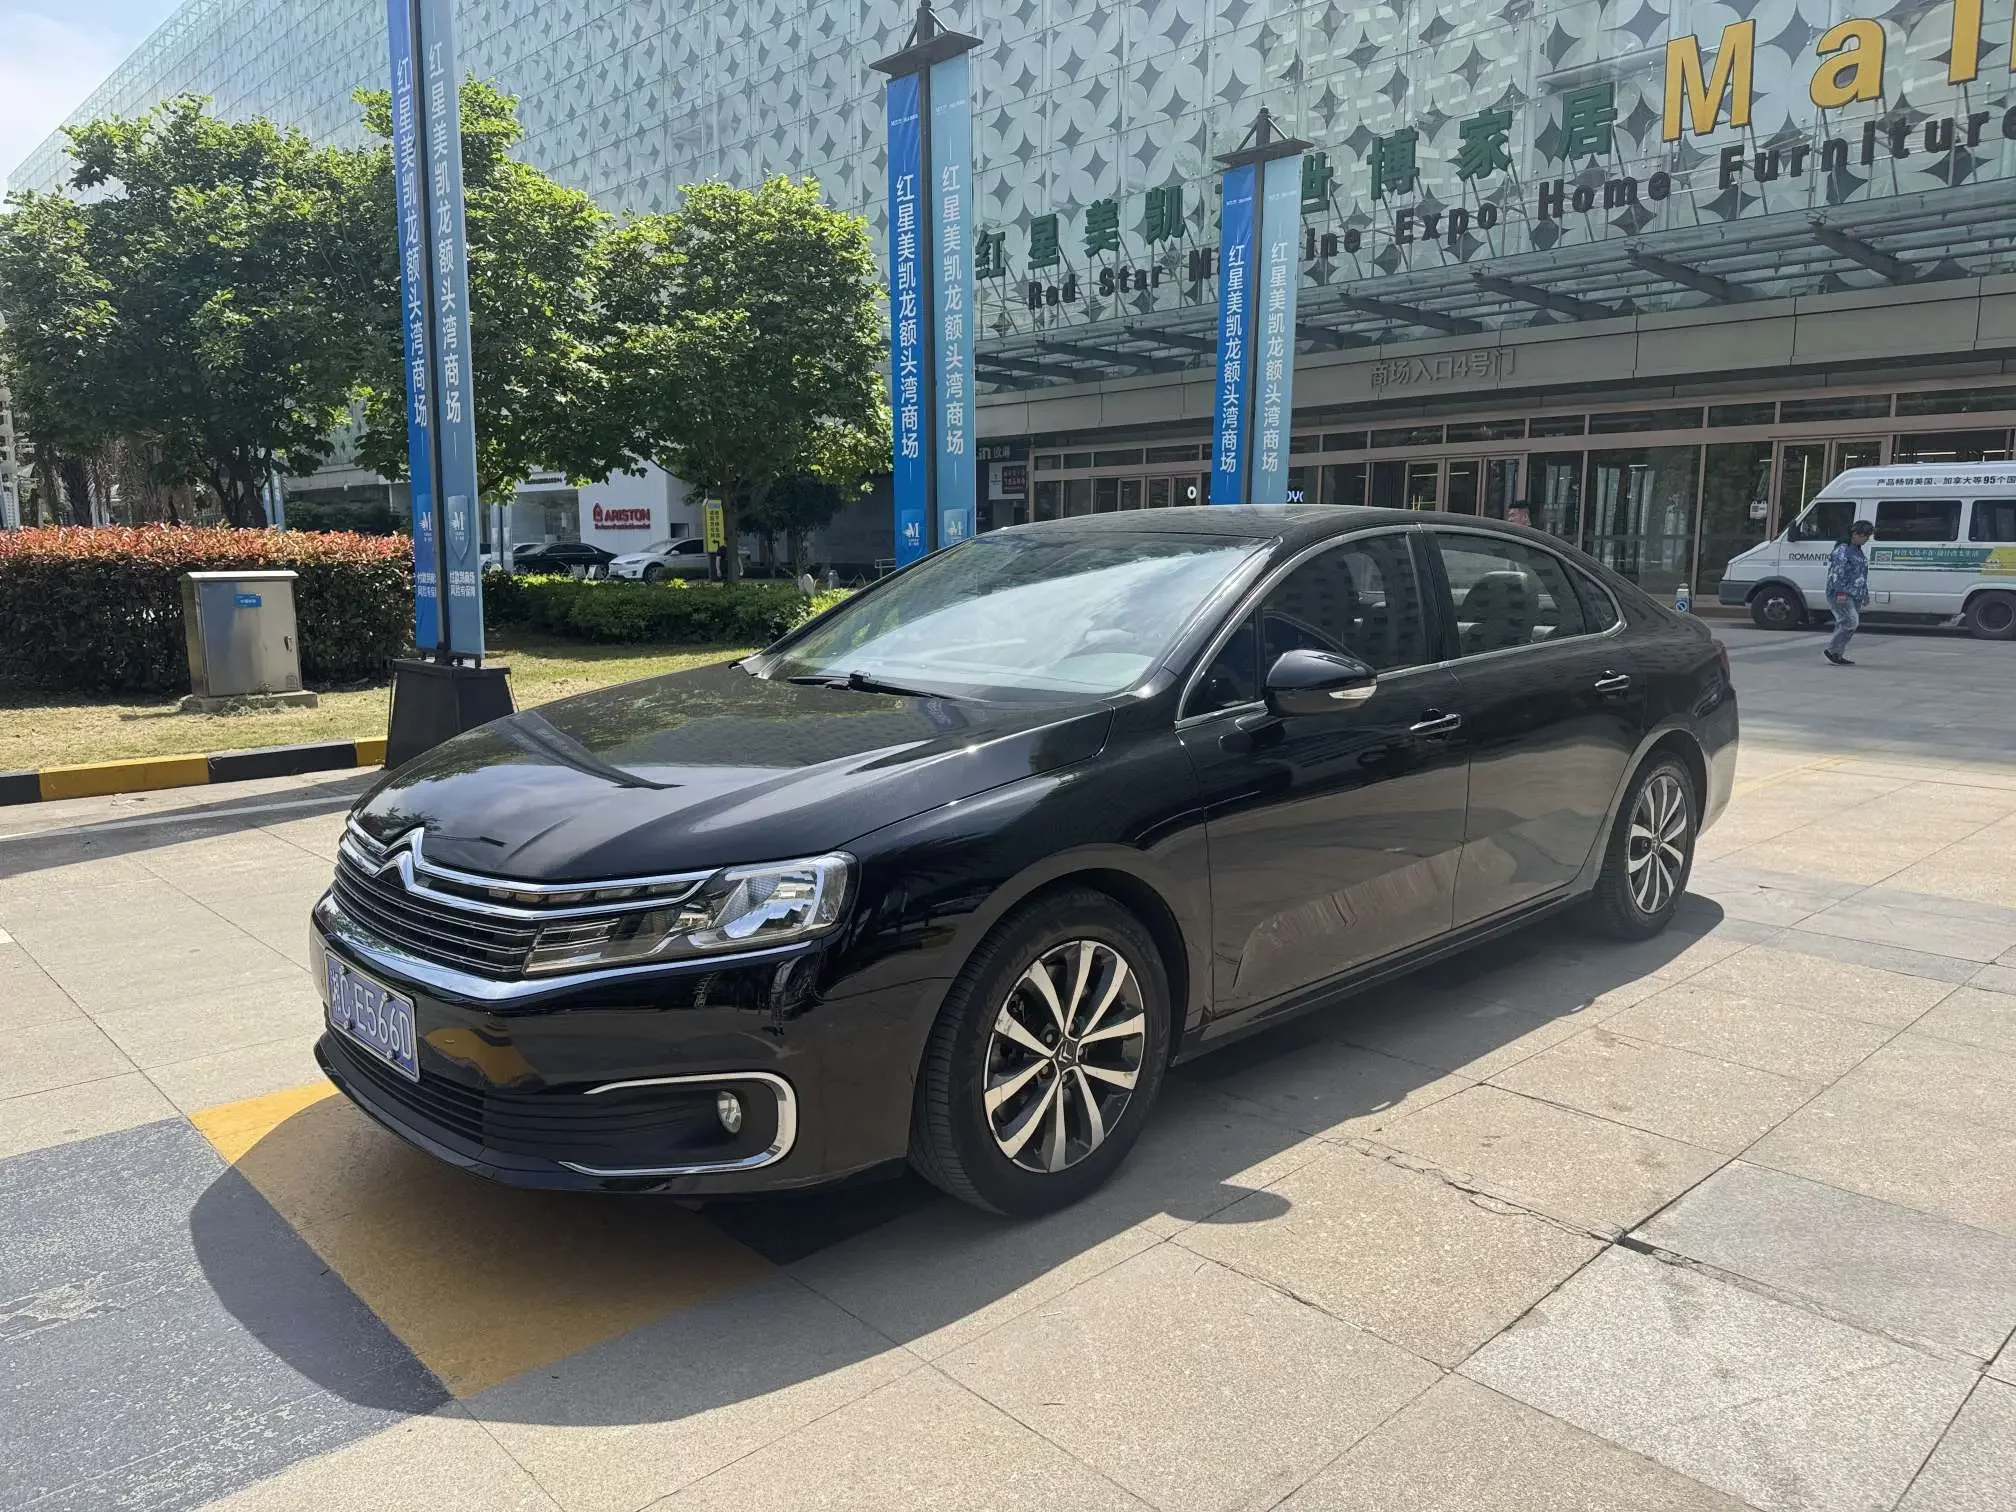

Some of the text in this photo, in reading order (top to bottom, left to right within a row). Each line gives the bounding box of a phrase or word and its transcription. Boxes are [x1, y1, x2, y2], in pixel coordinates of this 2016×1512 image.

[396, 56, 428, 427] 红星美凯龙额头湾商场
[428, 41, 461, 424] 红星美凯龙额头湾商场
[975, 0, 2016, 280] 红星美凯世博家居 Mal
[1028, 273, 1076, 310] Red
[1099, 265, 1163, 297] Star
[1396, 203, 1498, 246] Expo
[1538, 171, 1671, 221] Home
[896, 173, 920, 459] 红星美凯龙额头湾商场
[942, 164, 964, 455] 红星美凯龙额头湾商场
[1219, 244, 1245, 473] 红星美凯龙额头湾商场
[1261, 242, 1288, 472] 红星美凯龙额头湾商场
[1371, 348, 1516, 389] 商场入口4号门
[604, 508, 651, 522] ARISTON
